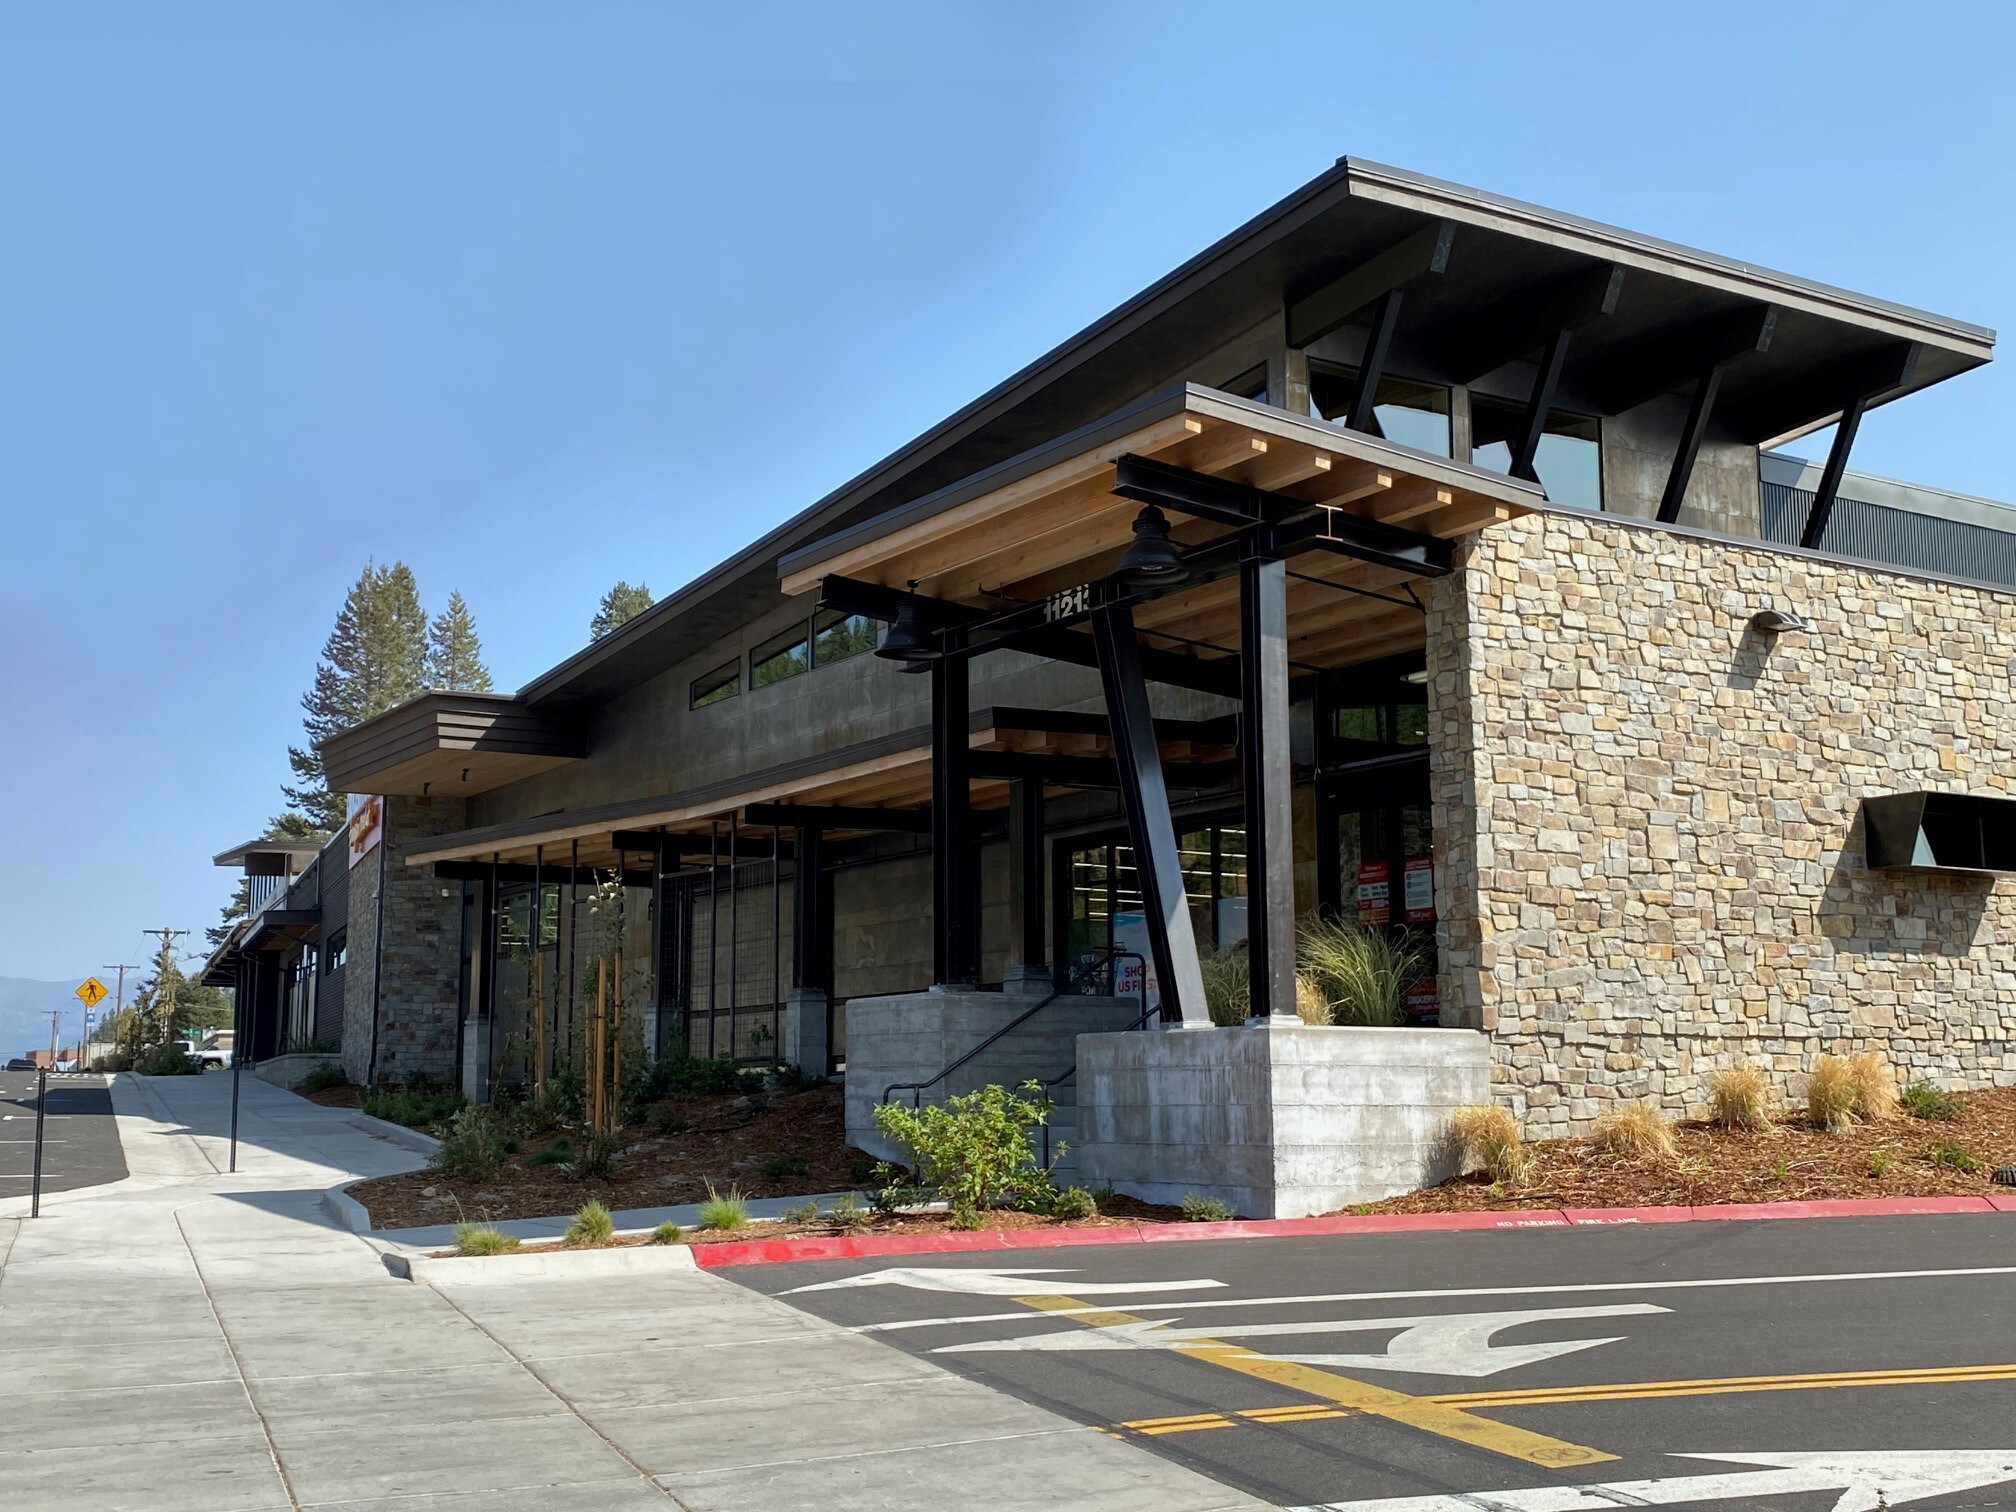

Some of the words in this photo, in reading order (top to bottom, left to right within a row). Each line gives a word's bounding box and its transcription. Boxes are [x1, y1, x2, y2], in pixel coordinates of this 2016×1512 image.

[1118, 981, 1131, 992] US
[1132, 979, 1157, 991] FIST
[1517, 1219, 1566, 1227] PARKING
